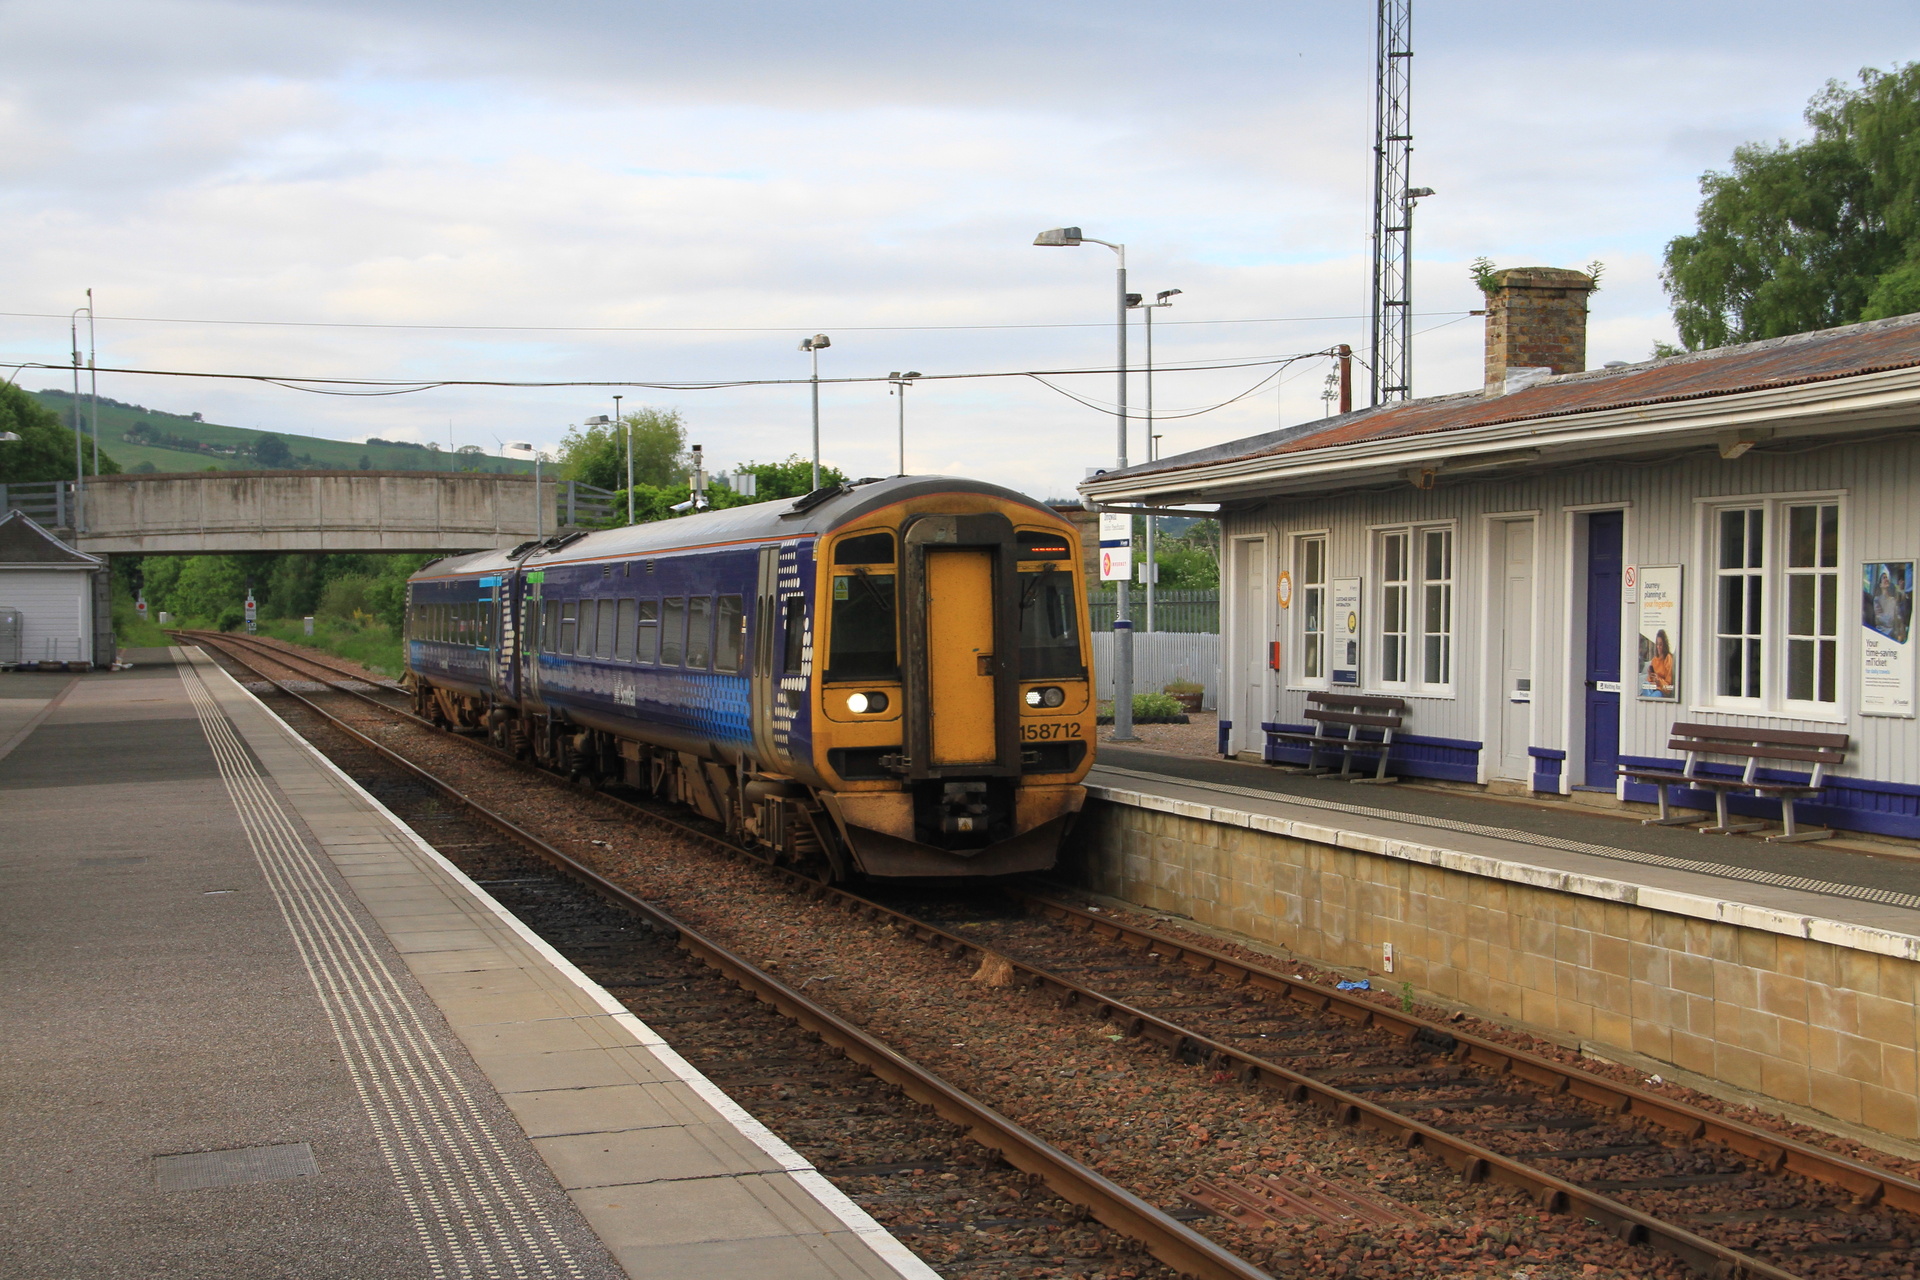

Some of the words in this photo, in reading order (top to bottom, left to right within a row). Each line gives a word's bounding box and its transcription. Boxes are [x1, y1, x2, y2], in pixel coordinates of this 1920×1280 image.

[1644, 581, 1660, 590] Journey
[1644, 591, 1661, 600] planning
[1866, 639, 1878, 647] Your
[1866, 648, 1897, 660] time-saving
[1866, 658, 1887, 667] mTicket
[1020, 723, 1081, 740] 158712
